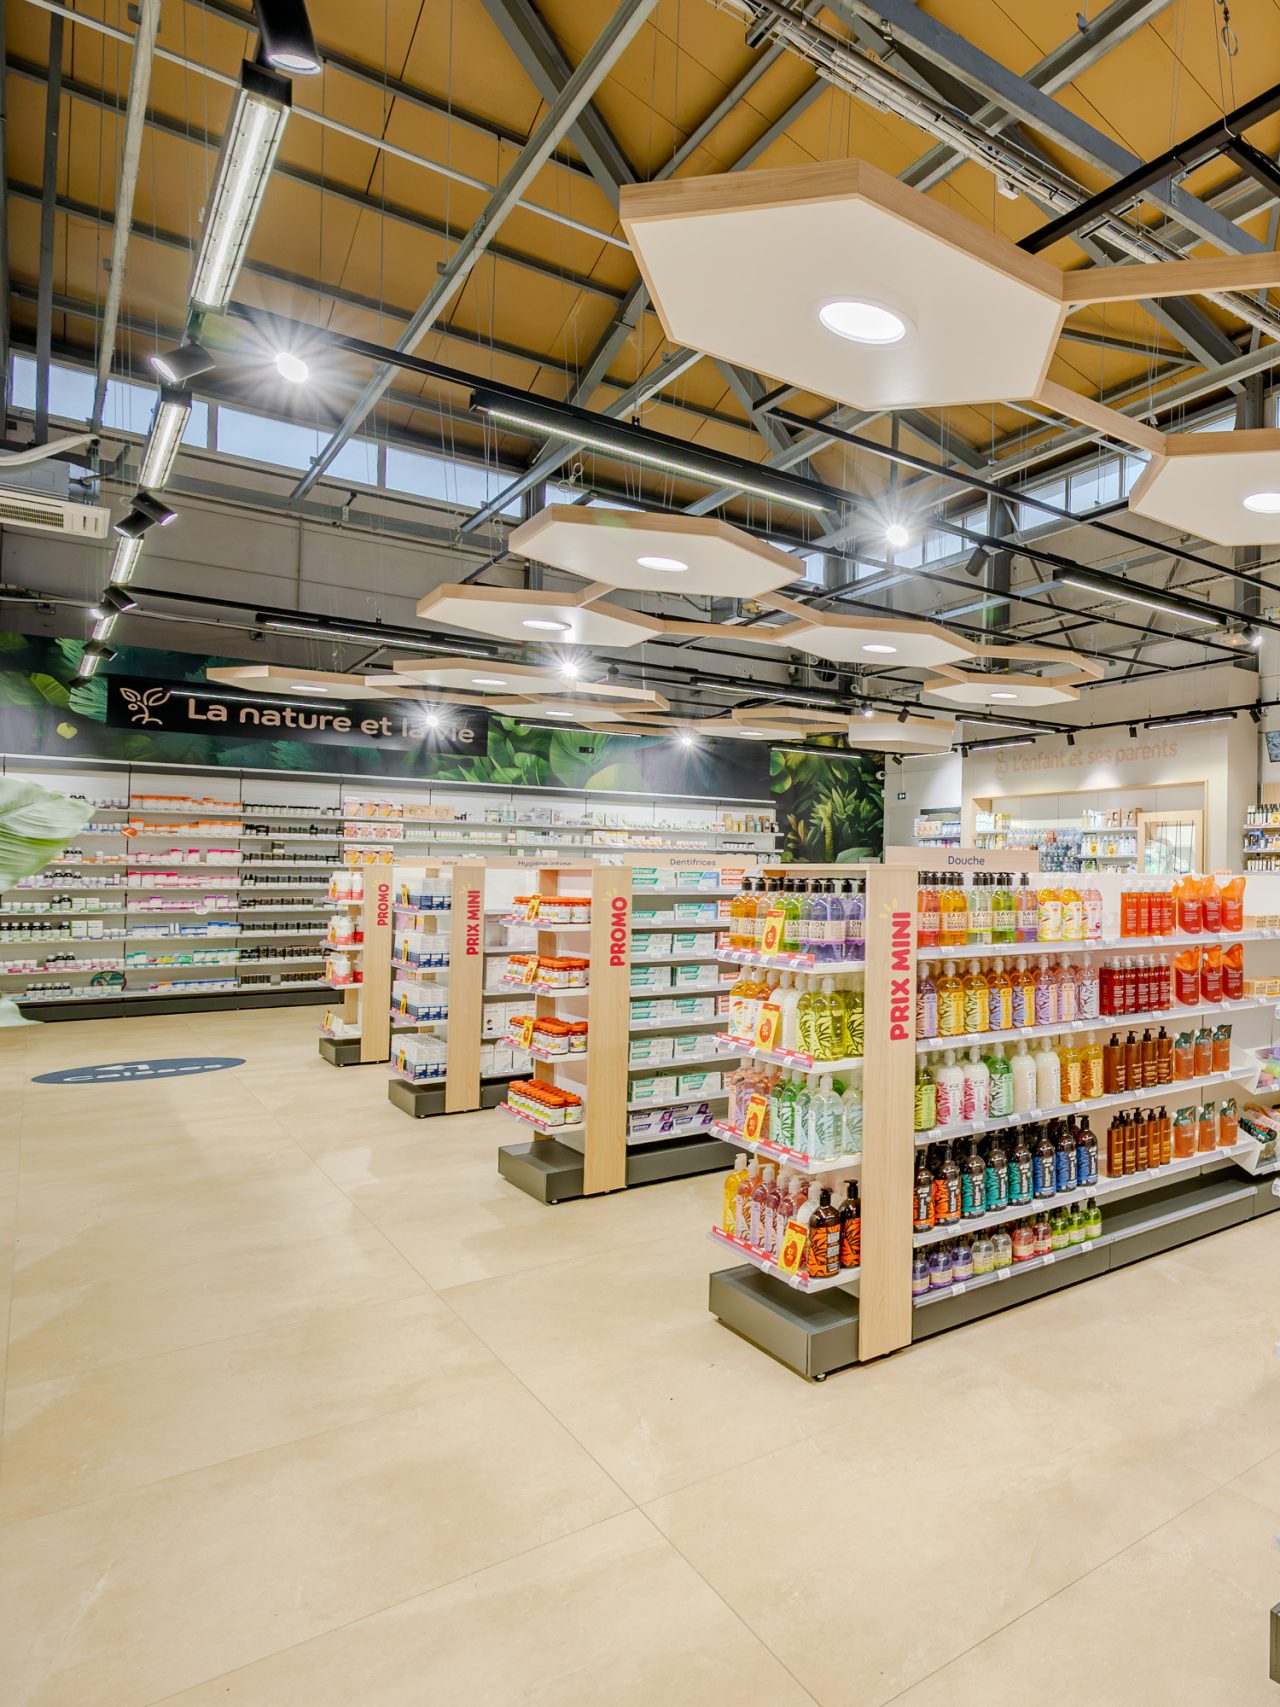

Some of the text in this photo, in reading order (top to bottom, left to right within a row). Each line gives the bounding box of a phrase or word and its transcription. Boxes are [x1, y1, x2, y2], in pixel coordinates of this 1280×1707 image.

[188, 698, 228, 722] La
[239, 706, 352, 733] nature
[360, 716, 393, 737] et
[402, 718, 425, 738] la
[1012, 740, 1178, 772] L'enfant et ses parents
[669, 858, 717, 866] Dentifrices
[947, 855, 985, 865] Douche
[377, 884, 389, 926] PROMO
[466, 890, 481, 955] PRIX MINI
[610, 897, 628, 966] PROMO
[890, 912, 912, 1041] PRIX MINI
